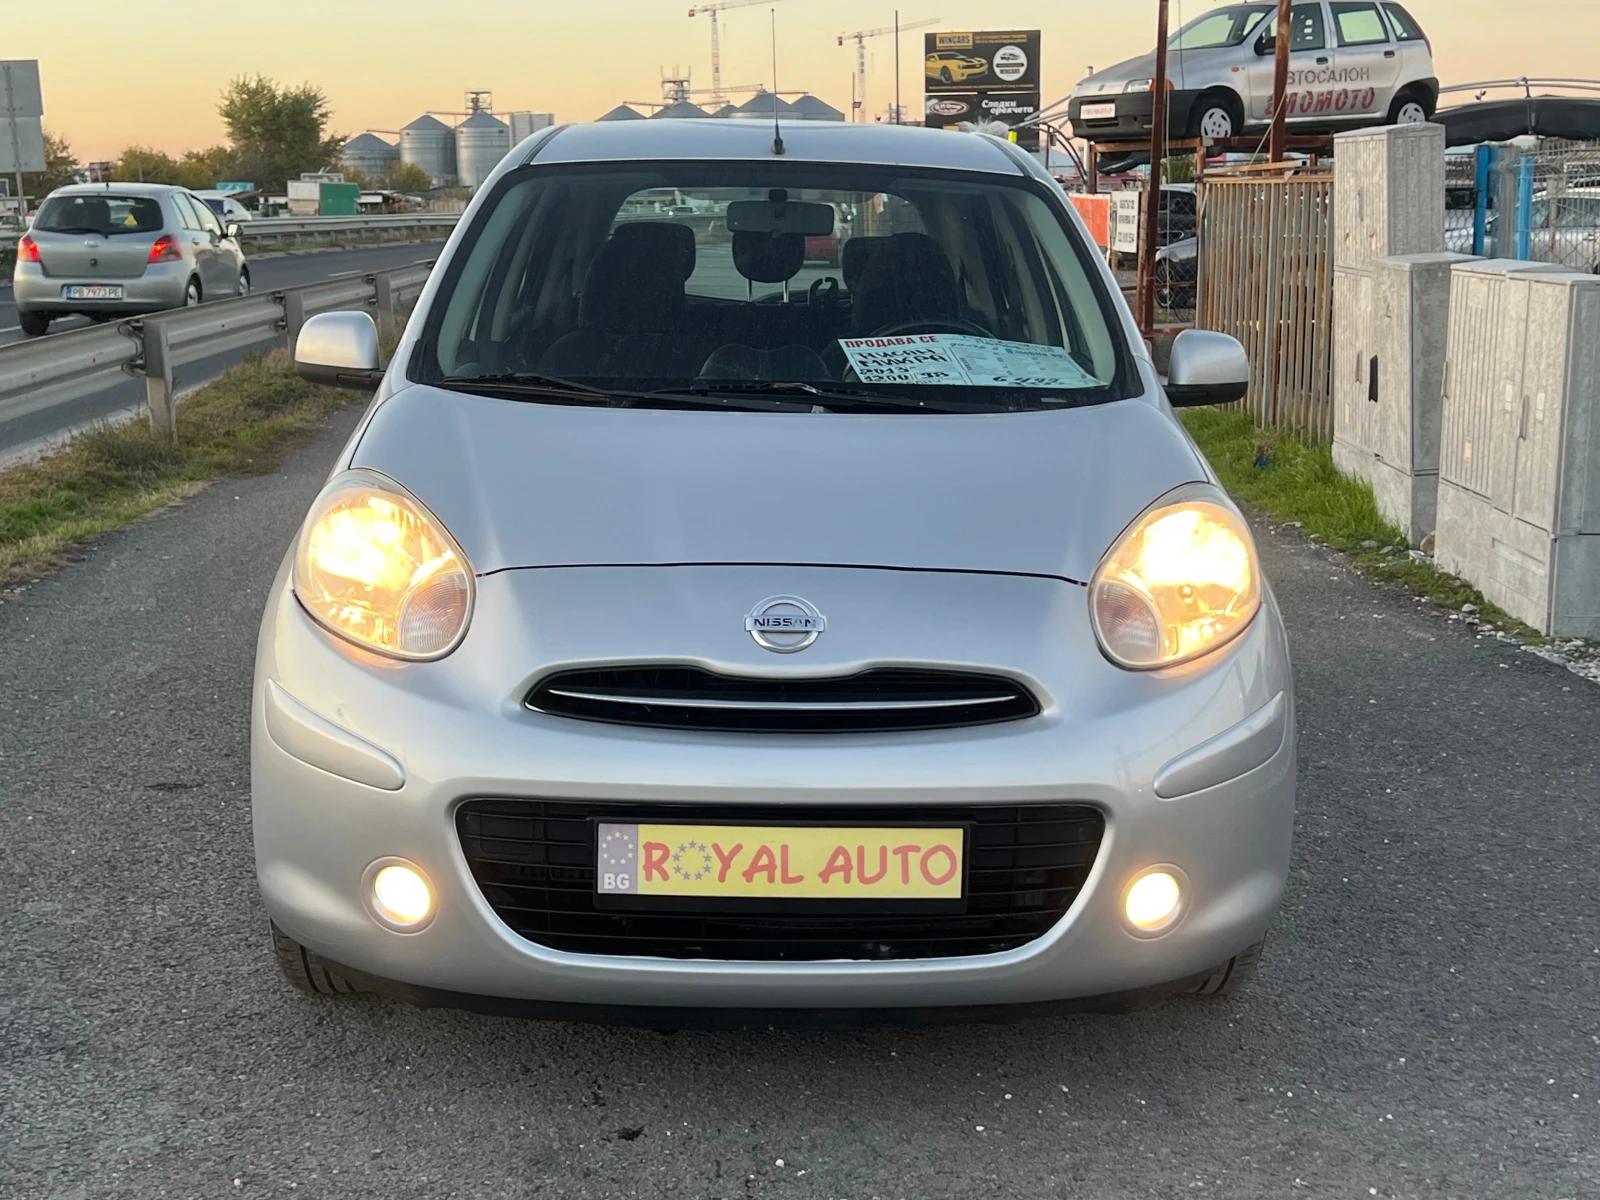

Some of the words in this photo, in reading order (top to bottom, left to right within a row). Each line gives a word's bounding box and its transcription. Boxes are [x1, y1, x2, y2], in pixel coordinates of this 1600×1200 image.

[938, 35, 970, 44] WINCARS
[1287, 67, 1370, 86] ВТОСАЛОН
[981, 100, 1017, 110] Сладки
[844, 337, 916, 348] ПРОДАВА
[919, 335, 940, 343] СЕ
[858, 355, 948, 367] МИКРА
[754, 618, 816, 628] NISSAN
[603, 873, 630, 889] BG
[642, 840, 804, 885] ROYAL
[818, 844, 957, 886] AUTO
